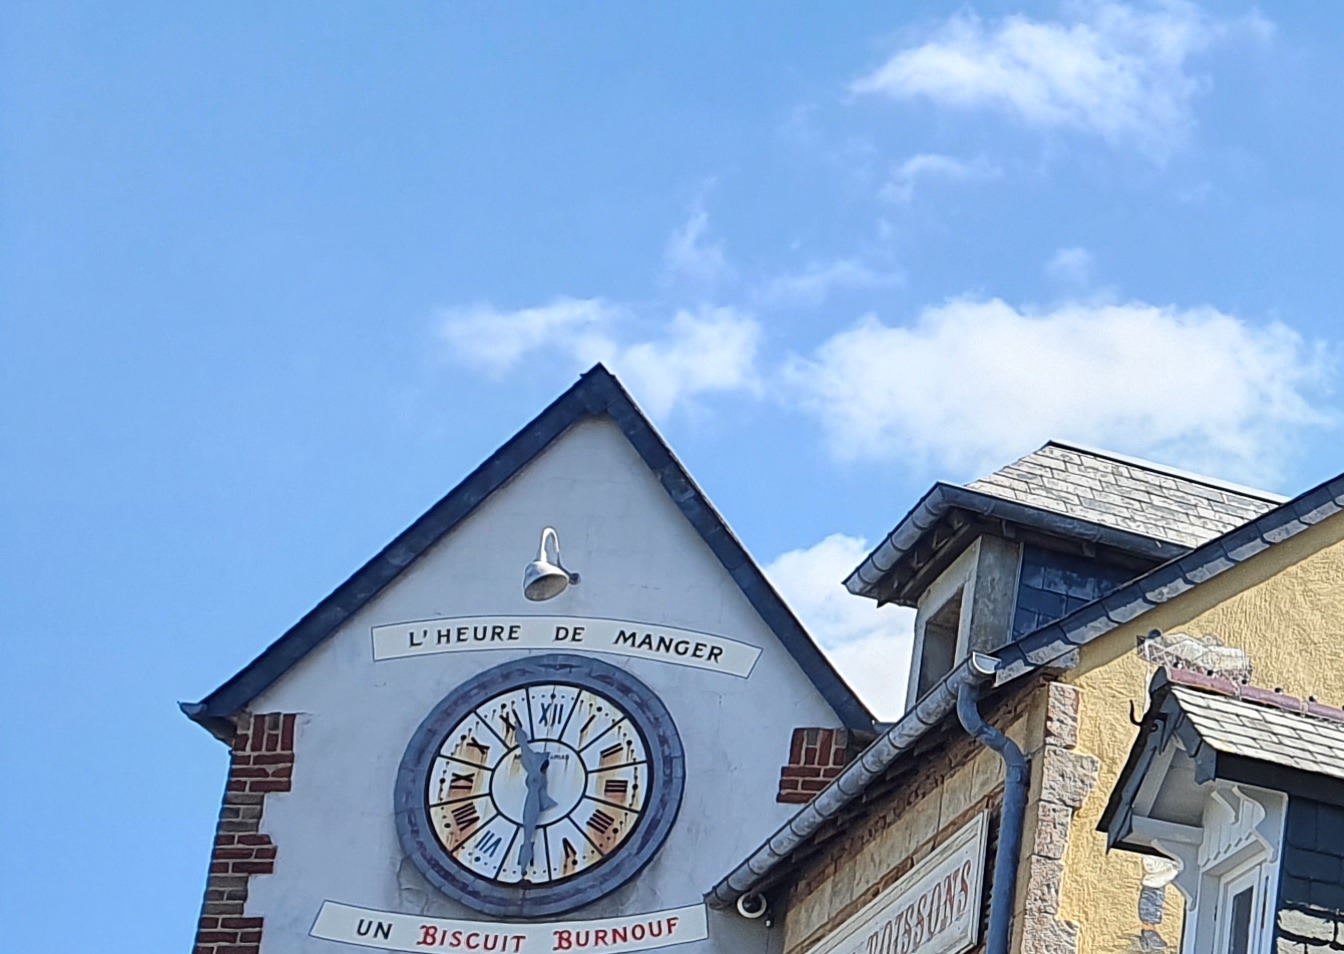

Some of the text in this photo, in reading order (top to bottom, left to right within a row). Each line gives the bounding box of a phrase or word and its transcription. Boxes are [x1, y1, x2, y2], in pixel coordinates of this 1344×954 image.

[408, 625, 724, 663] L'HEURE DE MANGER
[357, 918, 393, 940] UN
